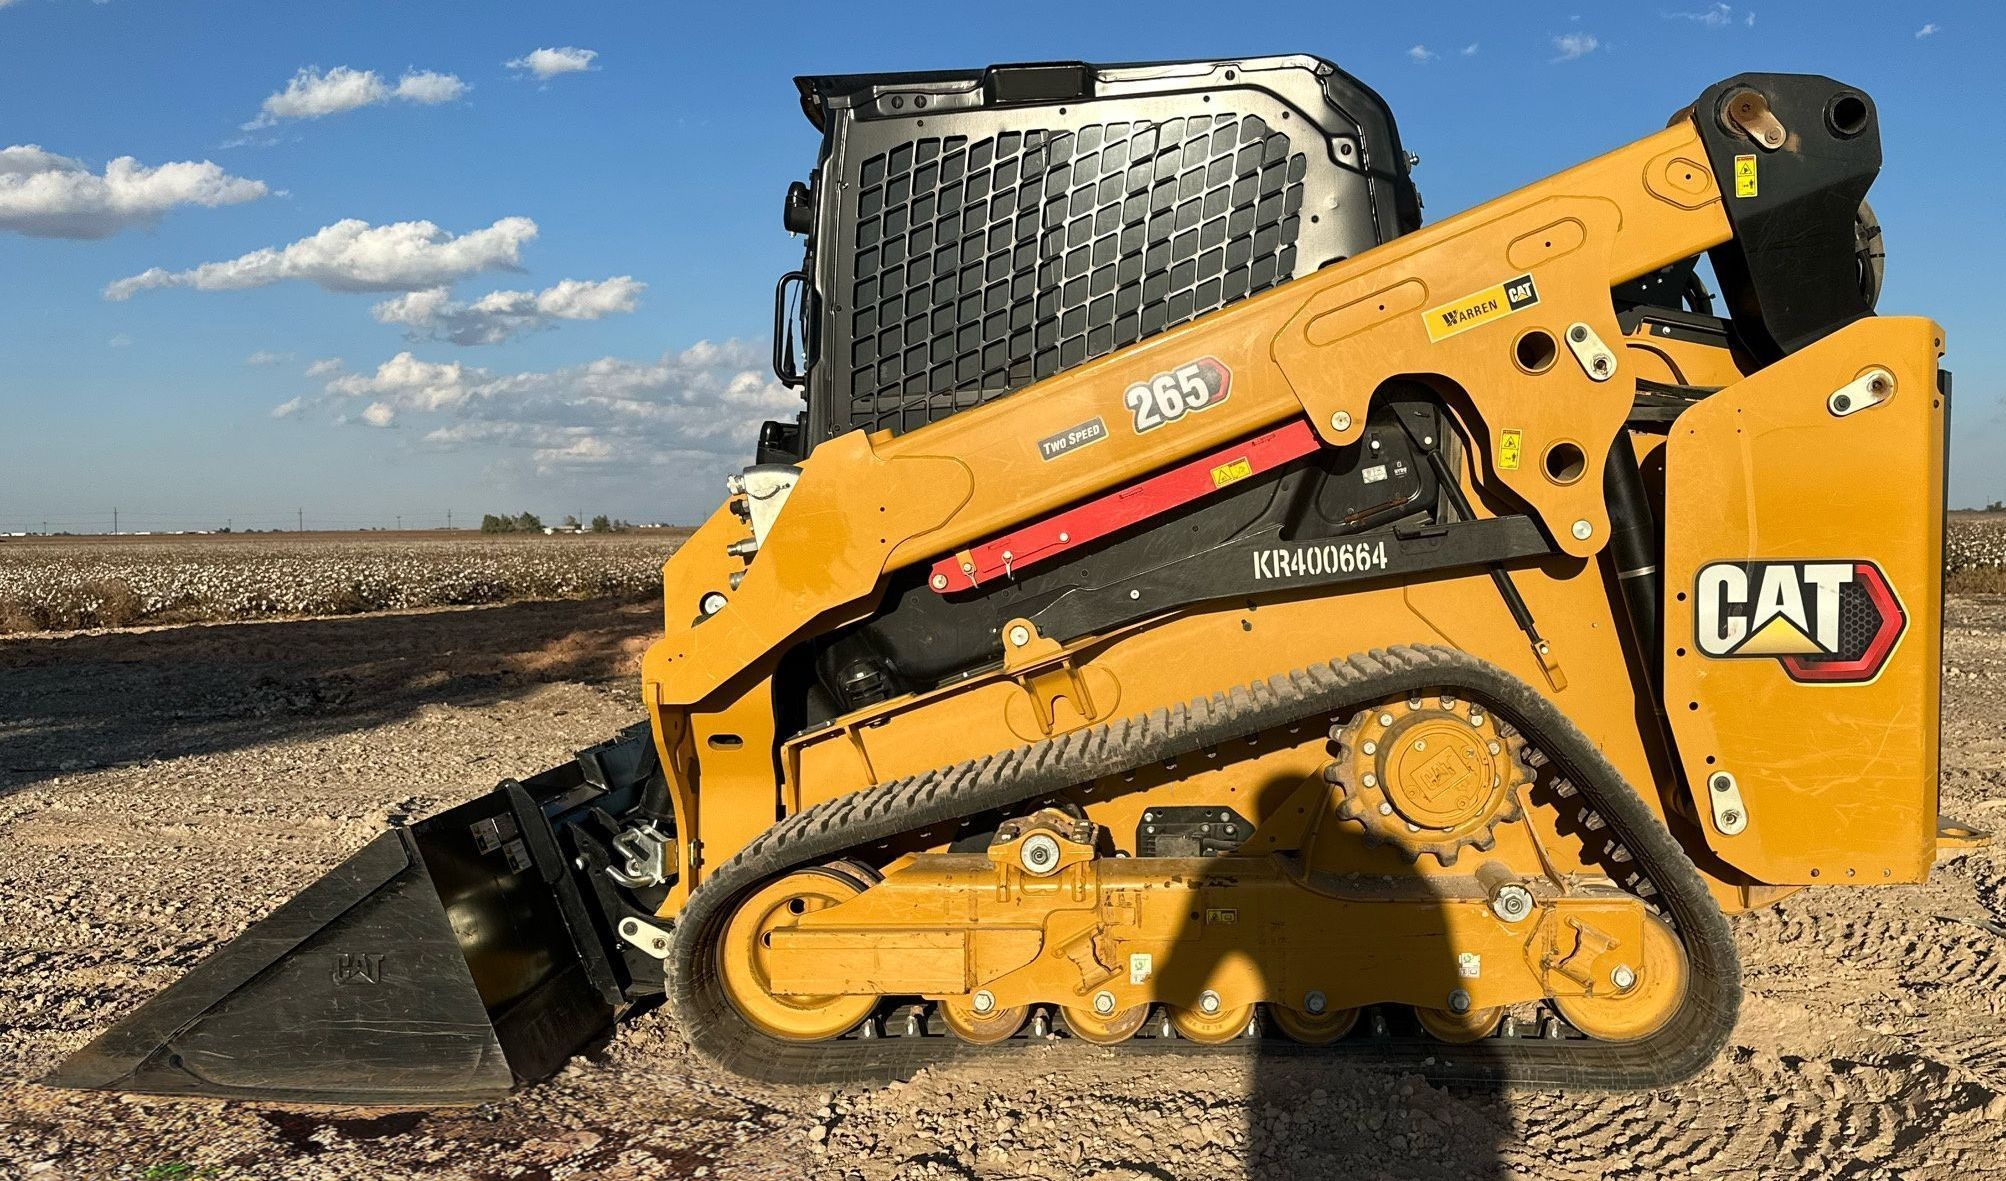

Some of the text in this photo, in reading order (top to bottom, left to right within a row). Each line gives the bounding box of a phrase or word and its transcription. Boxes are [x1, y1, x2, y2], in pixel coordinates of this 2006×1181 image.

[1508, 282, 1531, 303] CAT
[1442, 299, 1498, 327] WARREN
[1127, 365, 1210, 430] 265
[1043, 424, 1101, 455] TWO SPEED
[1253, 541, 1388, 580] KR400664
[1698, 564, 1853, 654] CAT
[334, 953, 384, 985] CAT
